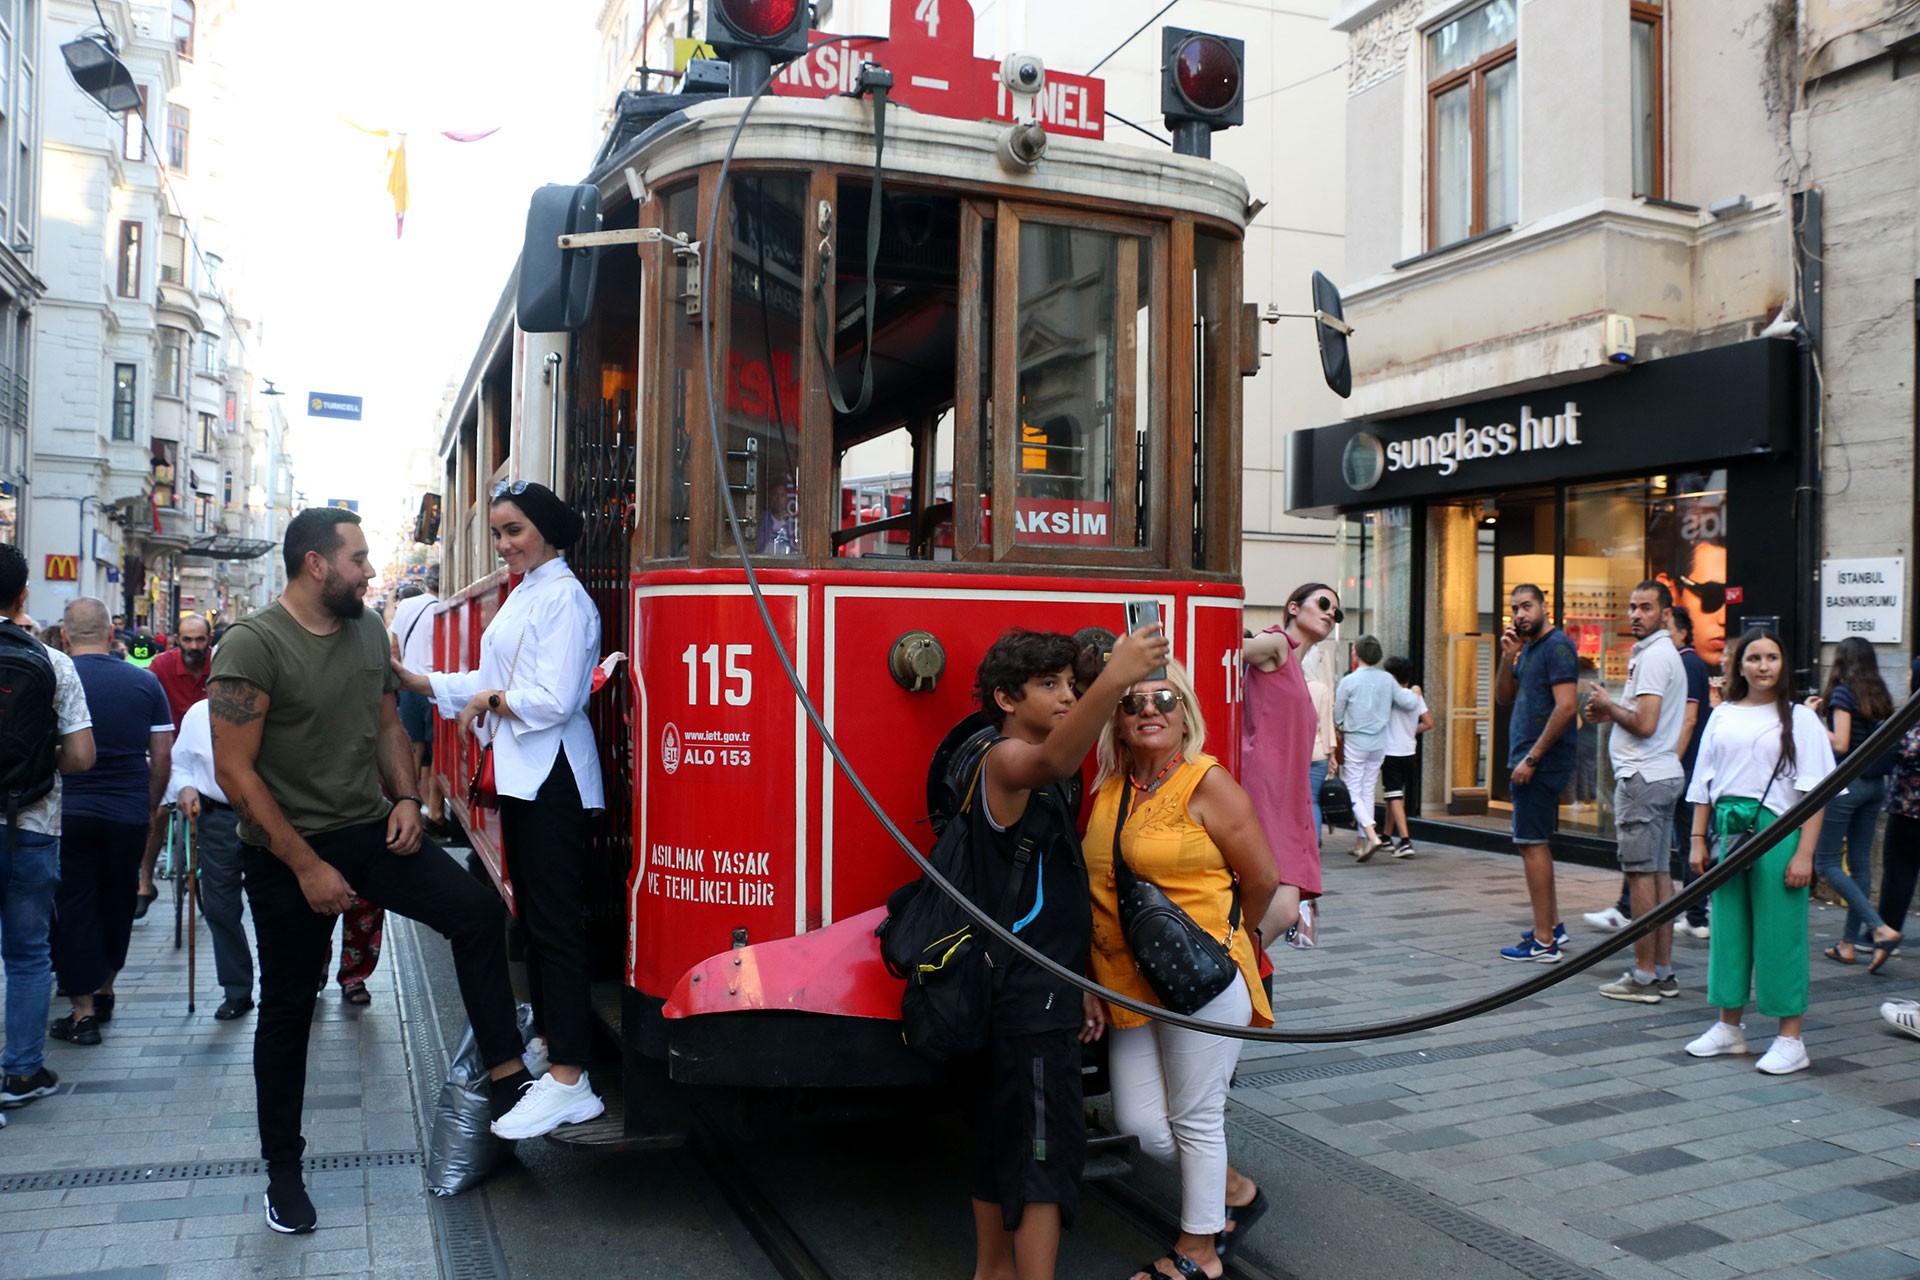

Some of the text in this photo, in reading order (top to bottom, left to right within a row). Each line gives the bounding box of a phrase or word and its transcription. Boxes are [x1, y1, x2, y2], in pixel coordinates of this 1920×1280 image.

[914, 0, 941, 37] 4
[992, 72, 1099, 131] TNEL
[1386, 401, 1582, 476] sunglass hut
[986, 507, 1107, 535] AKSİM
[1837, 570, 1884, 584] İSTANBUL
[1826, 595, 1897, 608] BASINKURUMU
[1846, 618, 1876, 632] TESİSİ
[682, 644, 752, 706] 115
[684, 730, 751, 744] www.iett.gov.tr
[684, 749, 751, 766] ALO 153
[651, 843, 770, 876] ASILMAK YASAK
[647, 871, 775, 906] VE TEHLİKELİDİR
